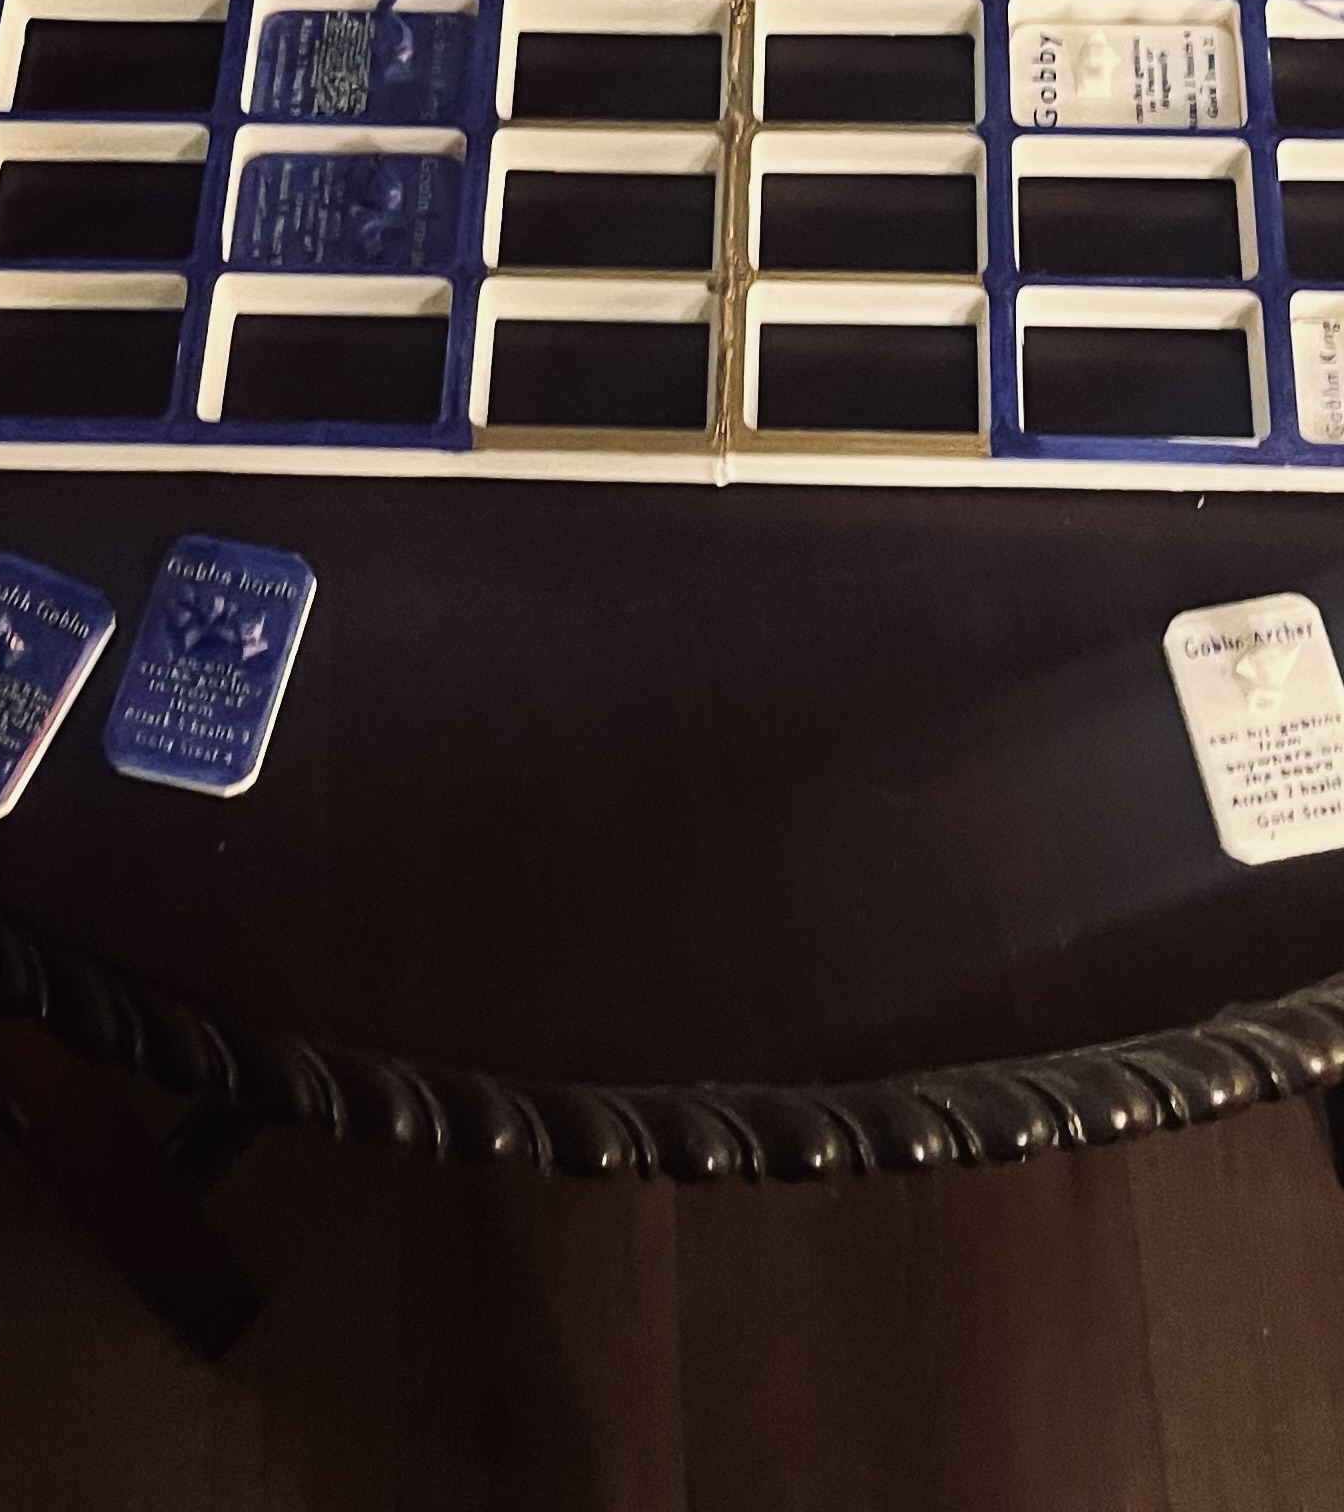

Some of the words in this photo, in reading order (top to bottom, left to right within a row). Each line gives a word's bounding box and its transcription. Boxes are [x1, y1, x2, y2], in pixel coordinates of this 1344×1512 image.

[1033, 34, 1064, 128] Gobby
[1184, 634, 1245, 656] Goblin
[1252, 621, 1314, 645] Archer
